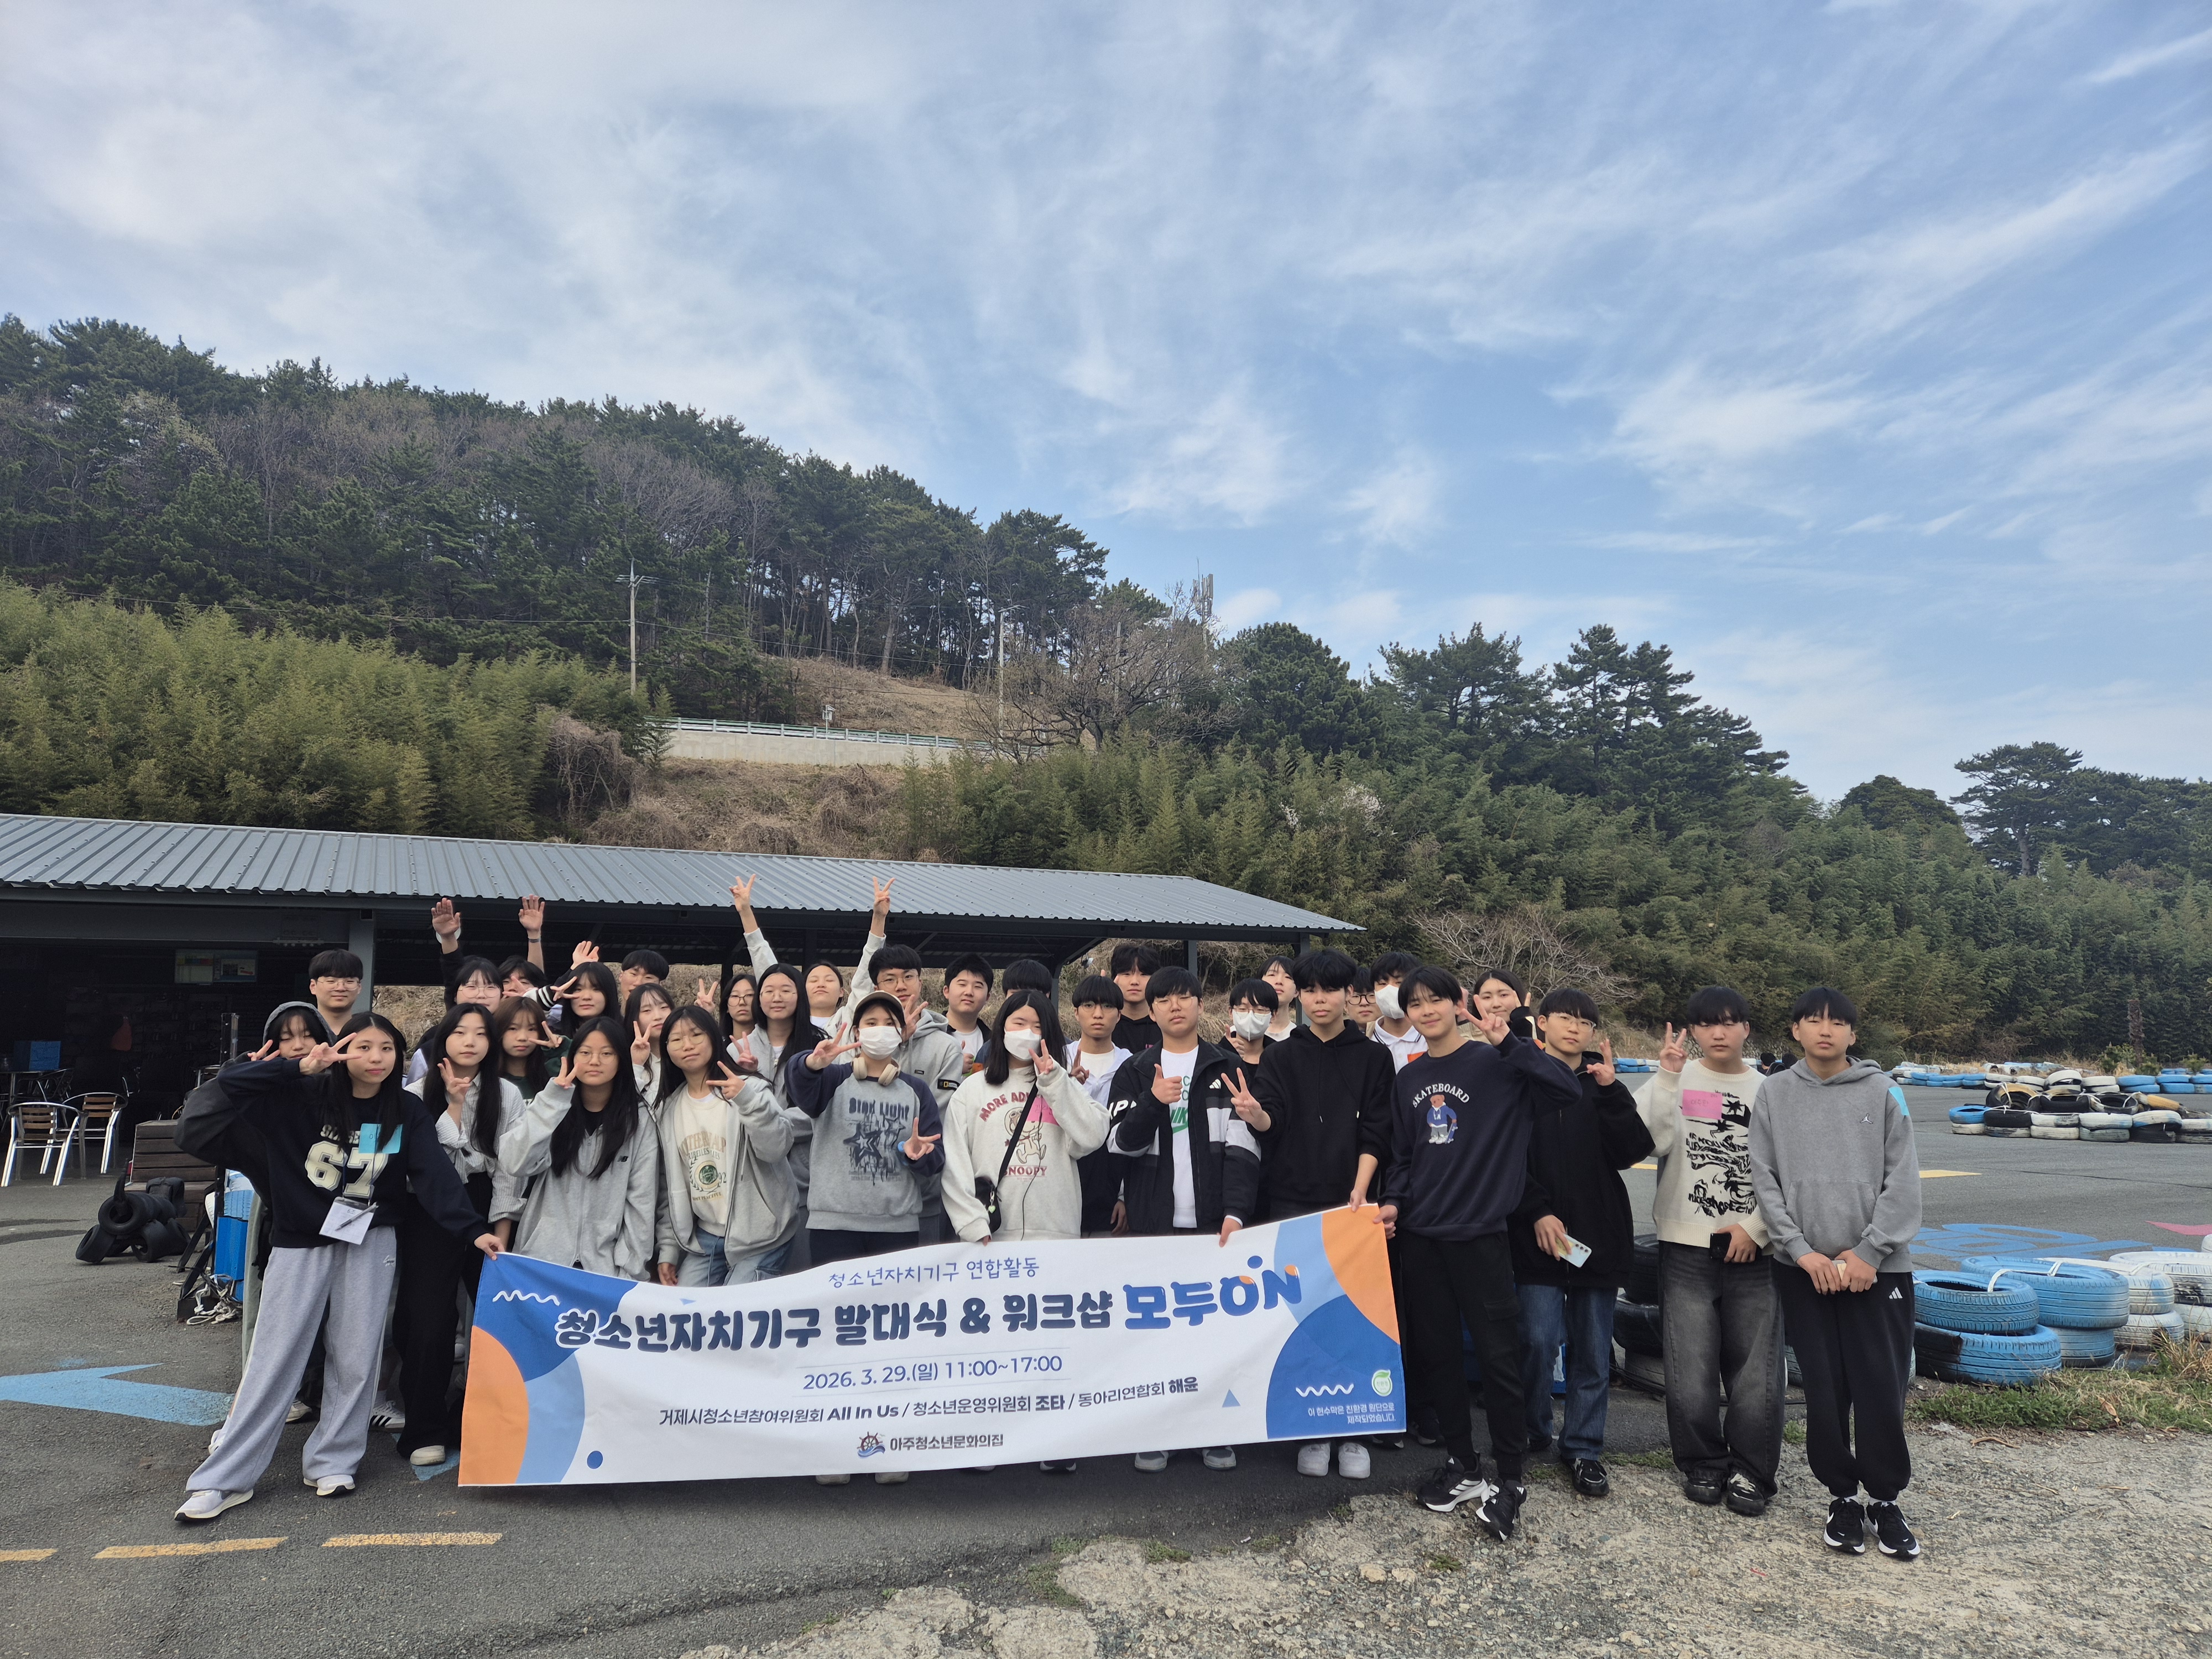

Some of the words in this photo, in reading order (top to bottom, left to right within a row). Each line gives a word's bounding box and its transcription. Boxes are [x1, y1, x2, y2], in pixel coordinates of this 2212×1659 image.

[979, 1094, 1009, 1122] MORE
[1412, 1083, 1470, 1108] SKATEBOARD
[305, 1140, 389, 1199] 67
[828, 1262, 959, 1288] 청소년자치기구
[966, 1256, 1040, 1280] 연합활동
[556, 1308, 821, 1353] 청소년자치기구
[834, 1298, 947, 1347] 발대식
[958, 1297, 991, 1334] &
[1001, 1290, 1113, 1333] 워크샵
[803, 1371, 857, 1391] 2026.
[860, 1369, 877, 1386] 3.
[881, 1362, 938, 1384] 29.(일)
[945, 1355, 1063, 1379] 11:00~17:00
[659, 1408, 824, 1426] 거제시청소년참여위원회
[827, 1406, 852, 1422] All
[855, 1407, 873, 1420] In
[877, 1405, 899, 1418] Us
[901, 1402, 911, 1418] /
[912, 1395, 1032, 1417] 청소년운영위원회
[1035, 1394, 1065, 1412] 조타
[1067, 1393, 1075, 1410] /
[1077, 1381, 1165, 1408] 동아리연합회
[1168, 1376, 1199, 1394] 해윤
[1308, 1407, 1315, 1417] 이
[1317, 1405, 1344, 1416] 현수막은
[1346, 1404, 1368, 1414] 친환경
[1369, 1402, 1395, 1412] 원단으로
[1347, 1413, 1396, 1425] 제작되었습니다.
[890, 1434, 1004, 1451] 아주청소년문화의집
